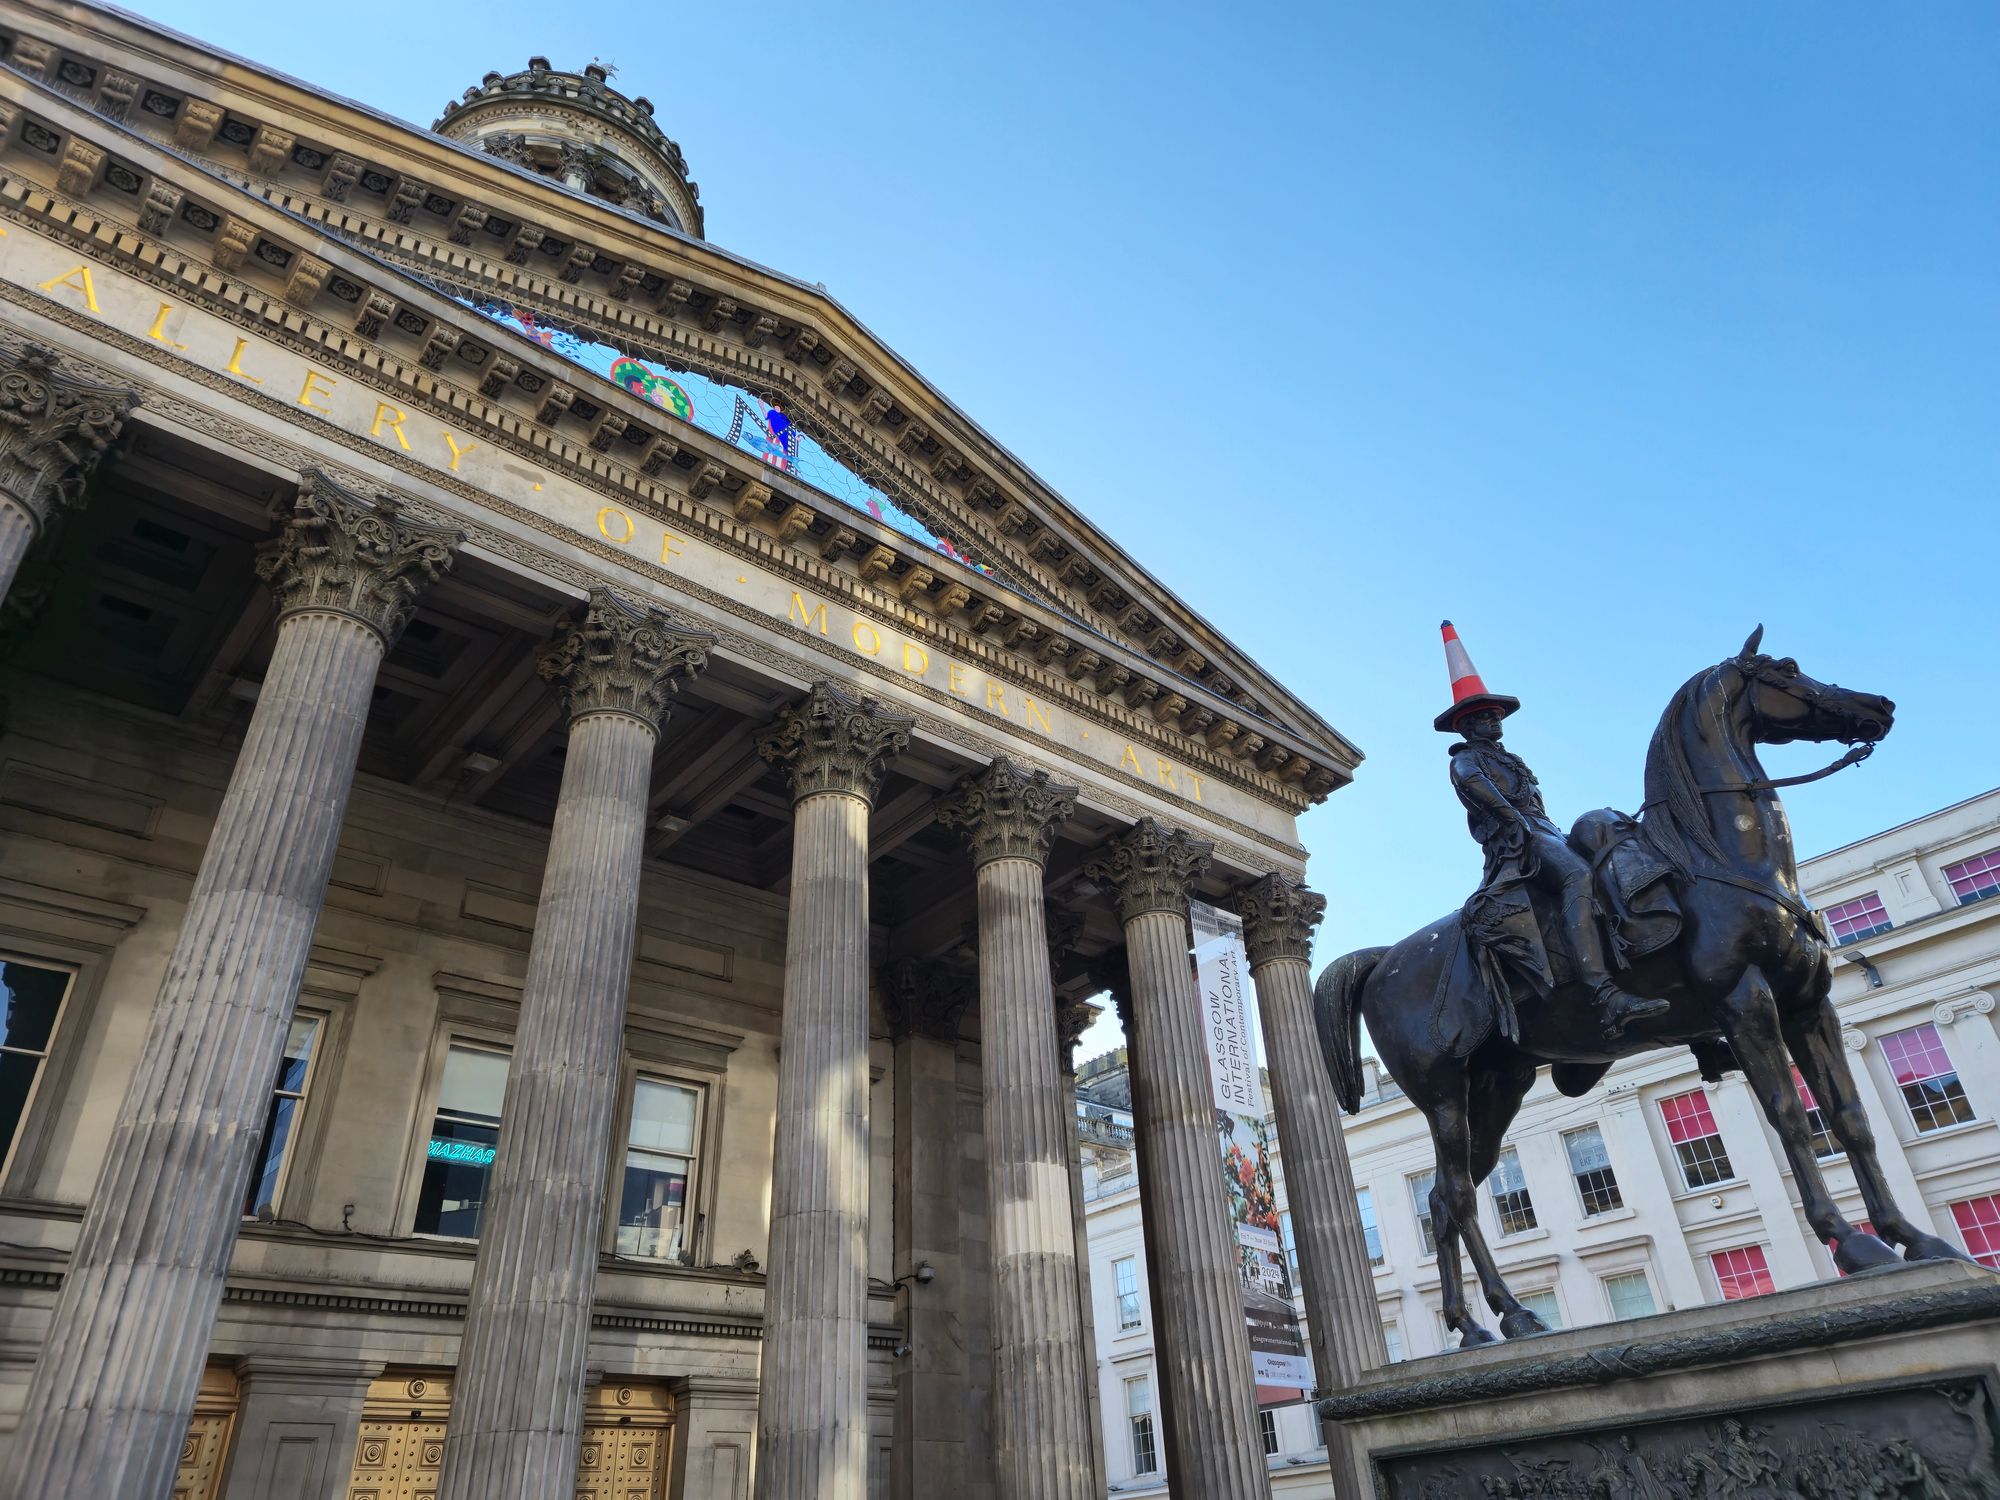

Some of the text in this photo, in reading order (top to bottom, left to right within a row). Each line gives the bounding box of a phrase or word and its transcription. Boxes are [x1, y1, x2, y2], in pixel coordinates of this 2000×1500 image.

[0, 229, 1206, 800] ALLERY OF MODERN ART
[1209, 990, 1231, 1099] GLASGOW
[1219, 947, 1245, 1104] INTERNATIONAL
[1233, 969, 1247, 1046] Contemporary
[1240, 1047, 1249, 1060] of
[1243, 1062, 1254, 1107] Festival
[1261, 1266, 1280, 1279] 2024
